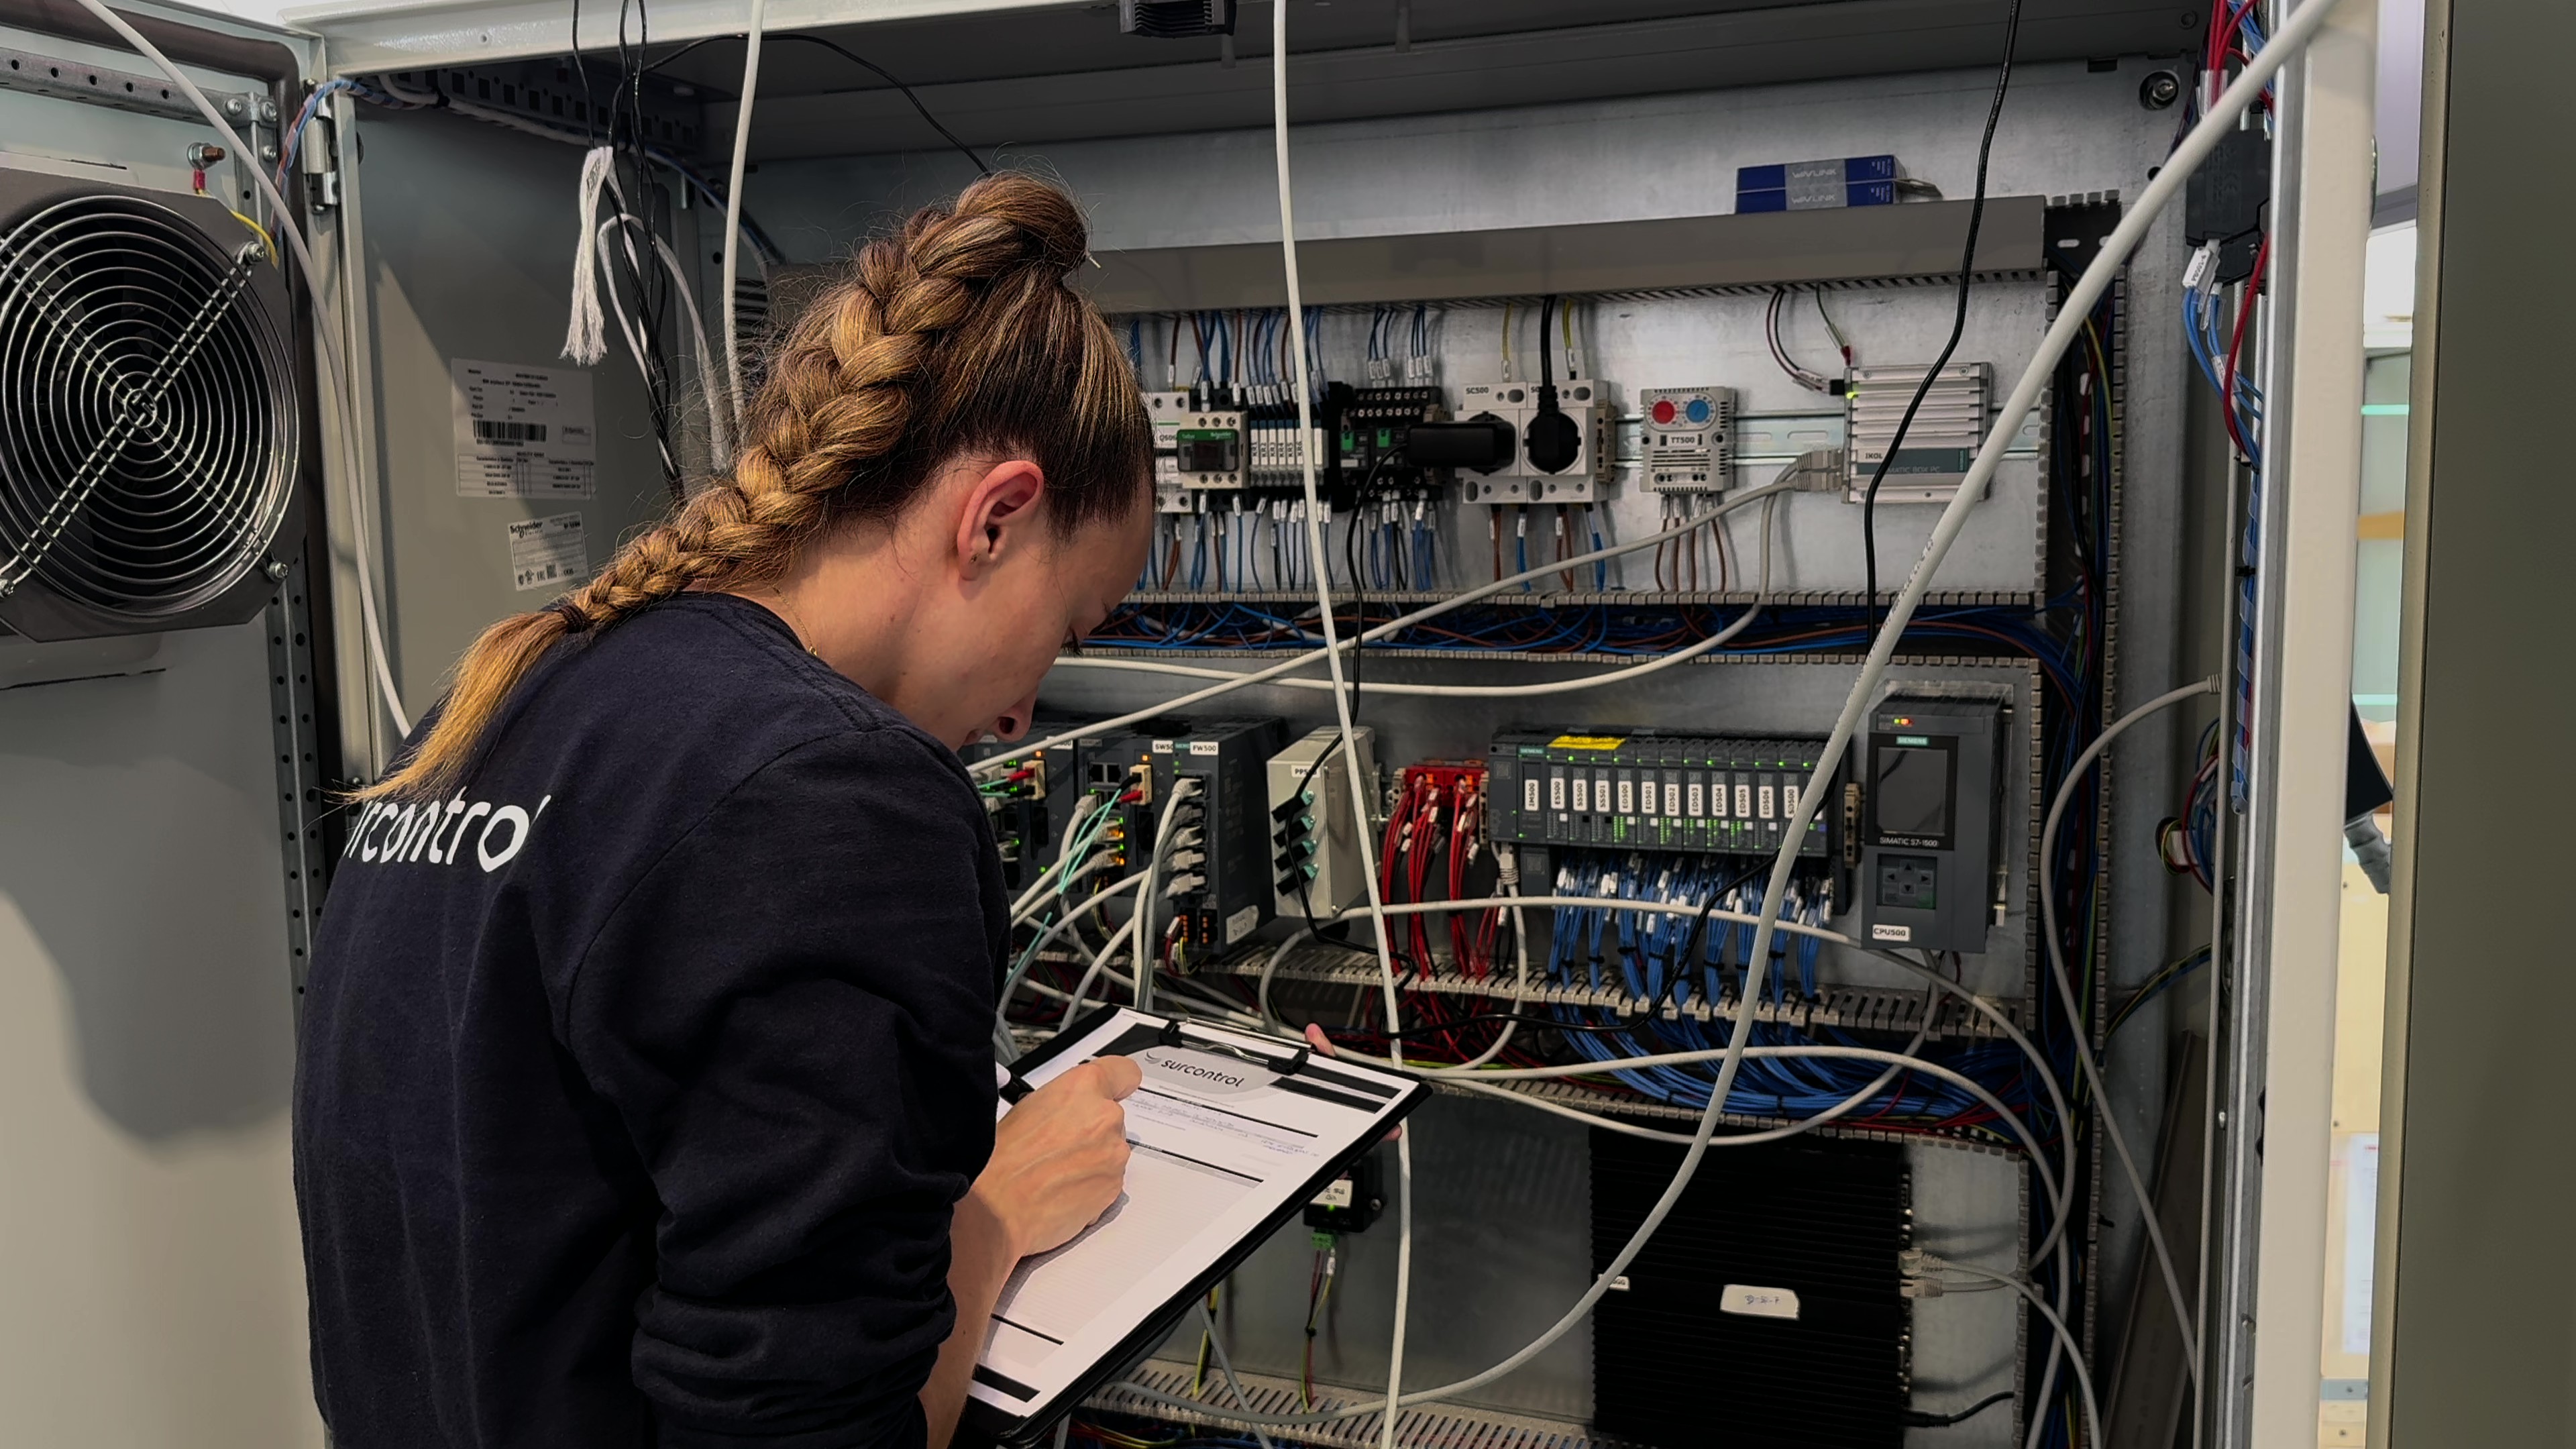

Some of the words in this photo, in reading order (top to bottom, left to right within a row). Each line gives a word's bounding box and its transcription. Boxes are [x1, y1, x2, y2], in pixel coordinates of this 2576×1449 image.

[1466, 386, 1489, 394] SC500
[1670, 436, 1695, 444] TT500
[1930, 465, 1941, 474] PC
[509, 521, 543, 539] Schneider
[1193, 744, 1217, 752] FW500
[1879, 837, 1909, 846] SIMATIC
[1911, 839, 1939, 847] S7-1500
[1874, 928, 1907, 936] CPU500
[1161, 1058, 1245, 1088] surcontrol
